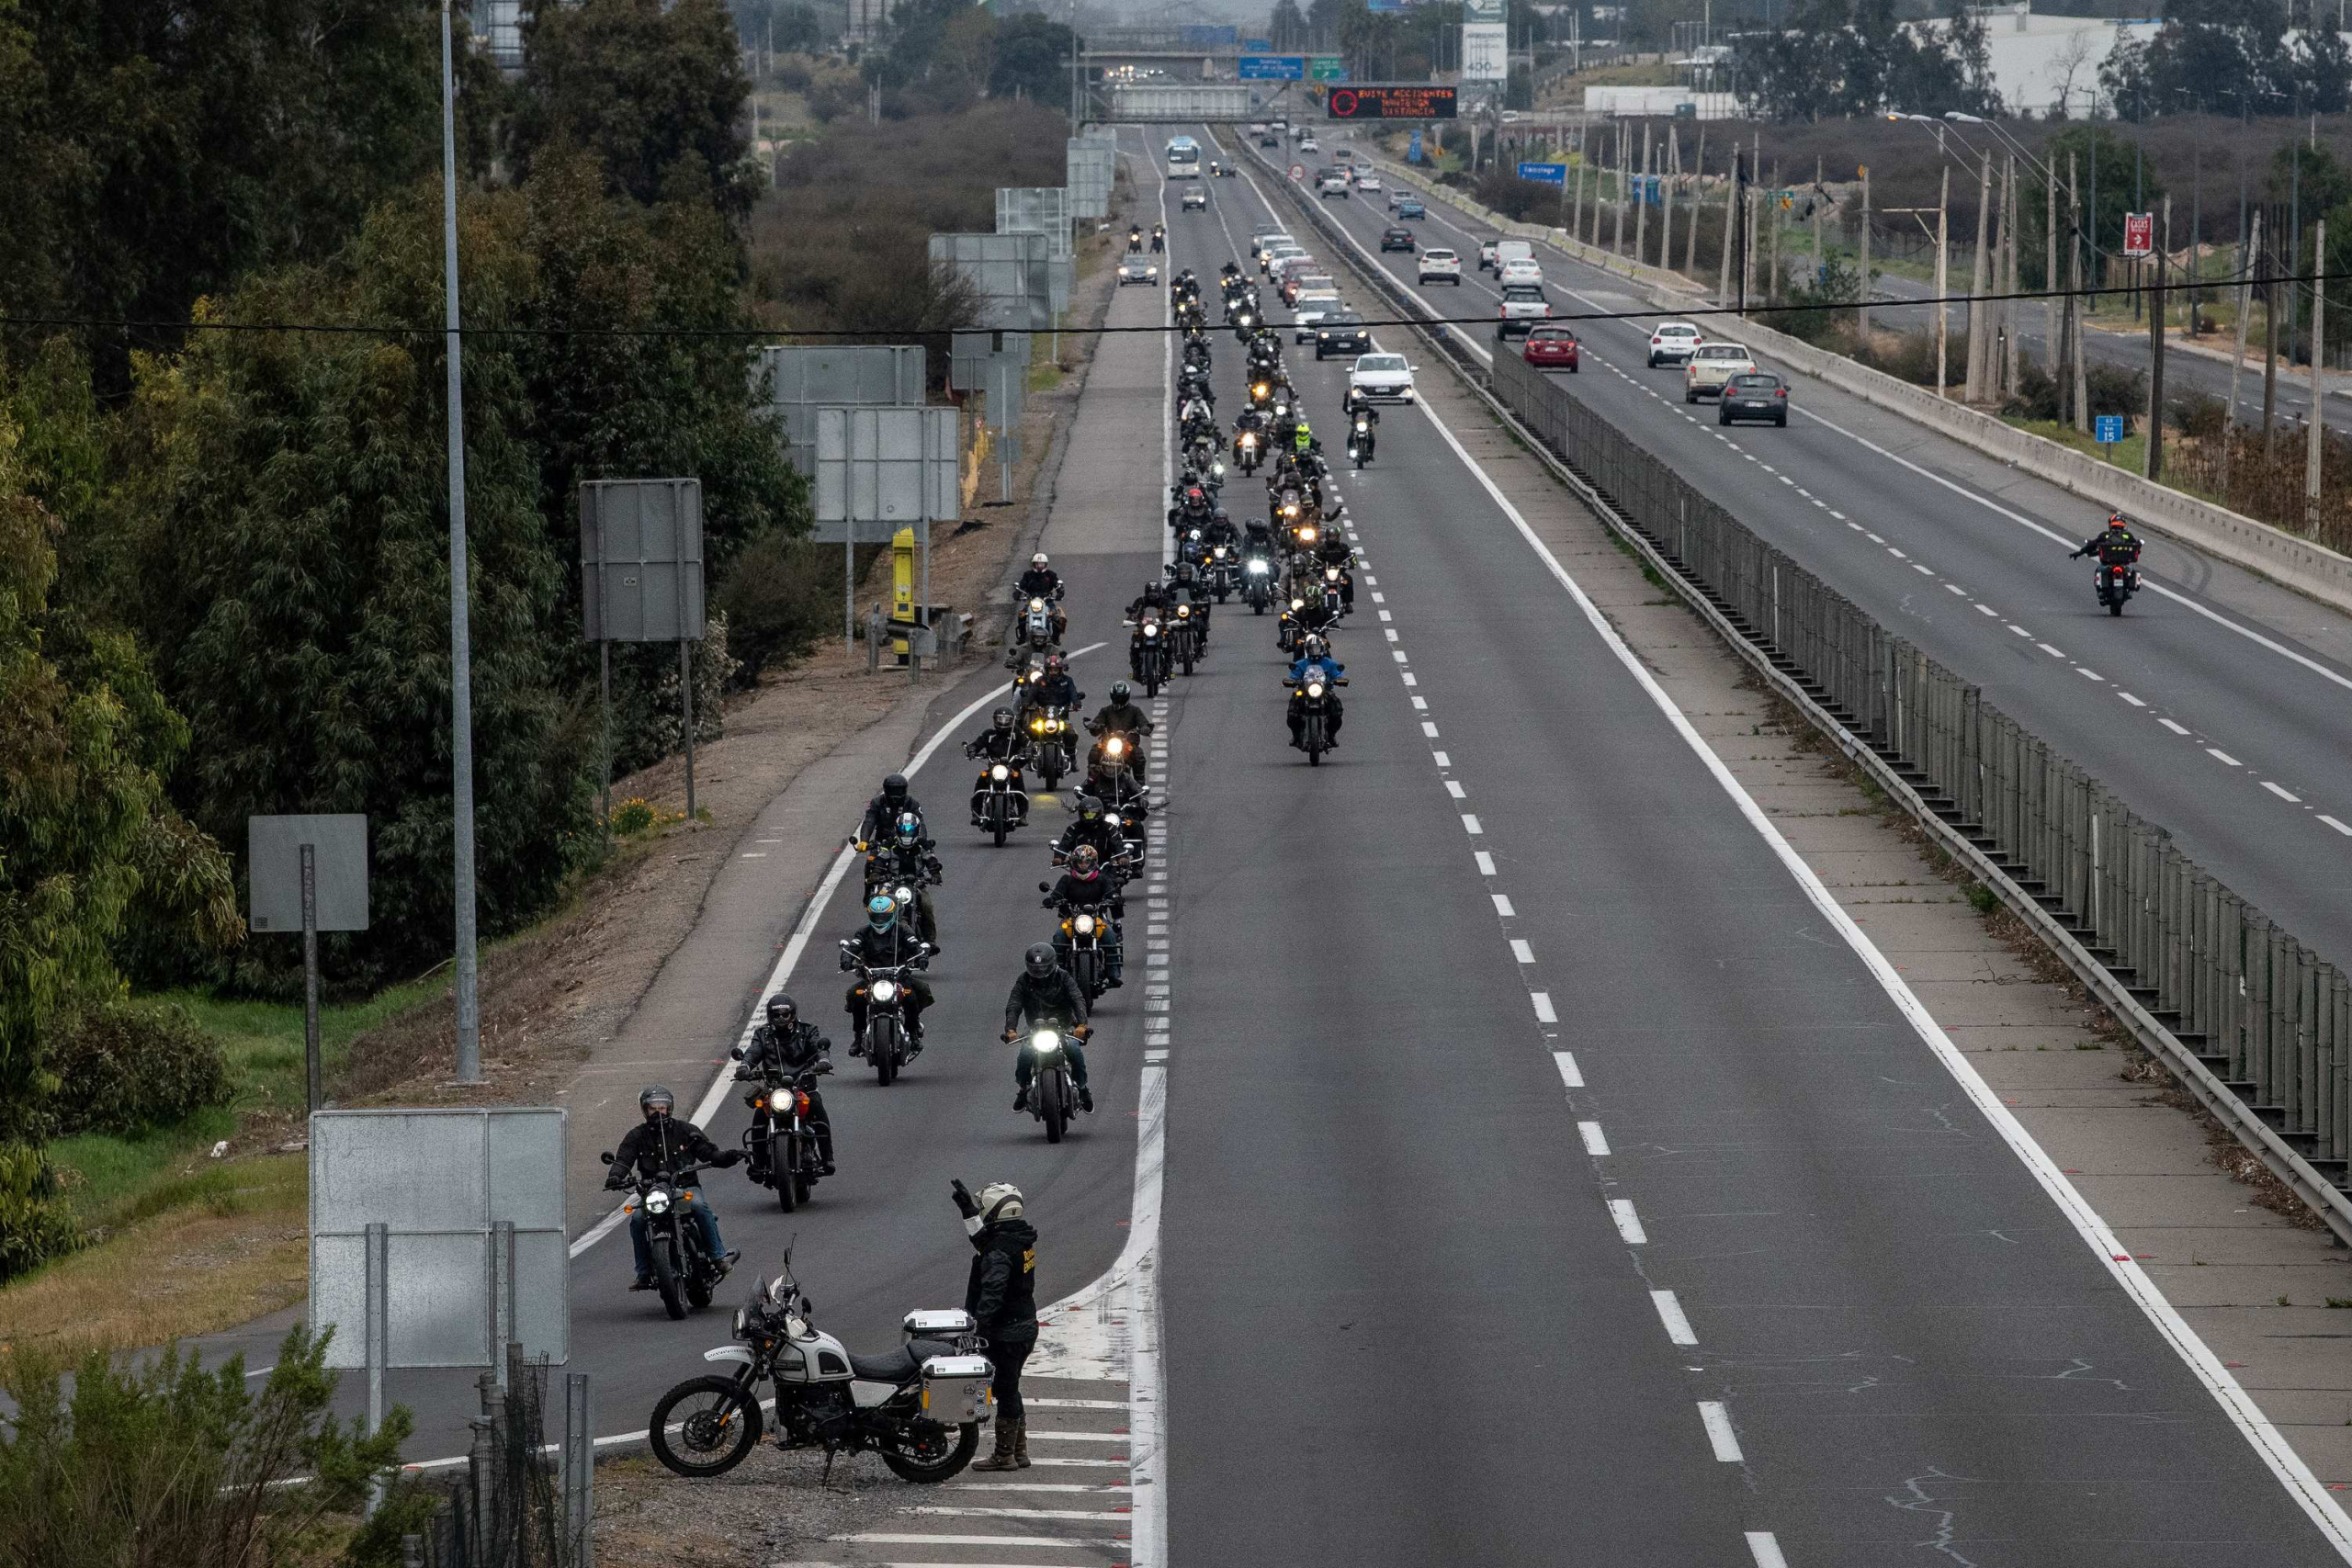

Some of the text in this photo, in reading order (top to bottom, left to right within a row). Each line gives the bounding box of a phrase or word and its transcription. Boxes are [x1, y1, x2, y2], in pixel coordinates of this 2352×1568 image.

[1468, 62, 1493, 71] 400
[1358, 90, 1453, 98] EVITE ACCIDENTES
[1382, 107, 1436, 116] DISTANCIA
[2131, 220, 2149, 229] CASAS
[2104, 432, 2115, 441] 15
